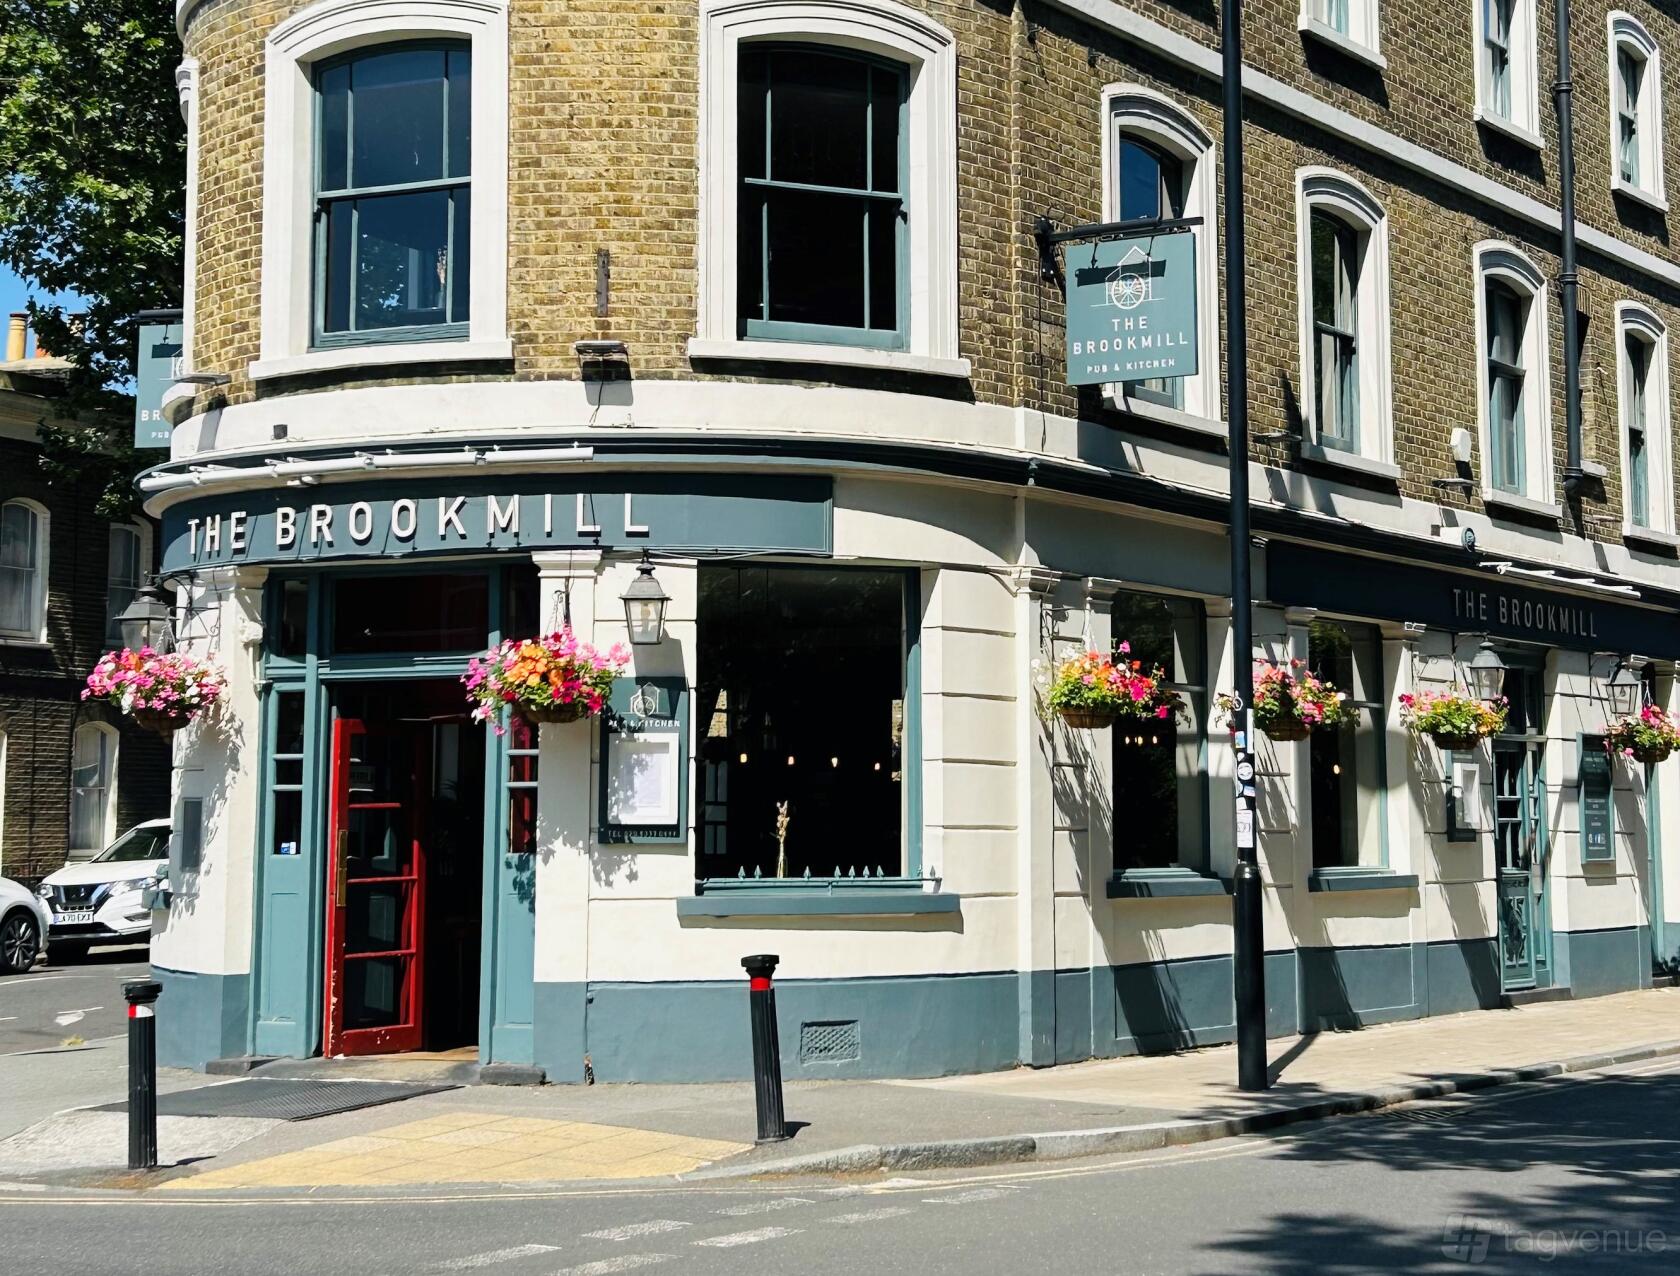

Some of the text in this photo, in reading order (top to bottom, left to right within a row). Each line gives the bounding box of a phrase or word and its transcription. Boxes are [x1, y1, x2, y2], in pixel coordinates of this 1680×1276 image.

[1112, 316, 1148, 331] THE
[1073, 332, 1189, 355] BROOKMILL
[1087, 359, 1176, 374] PUB & KITCHEN
[188, 492, 650, 555] THE BROOKMILL
[1453, 588, 1598, 638] THE BROOKMILL
